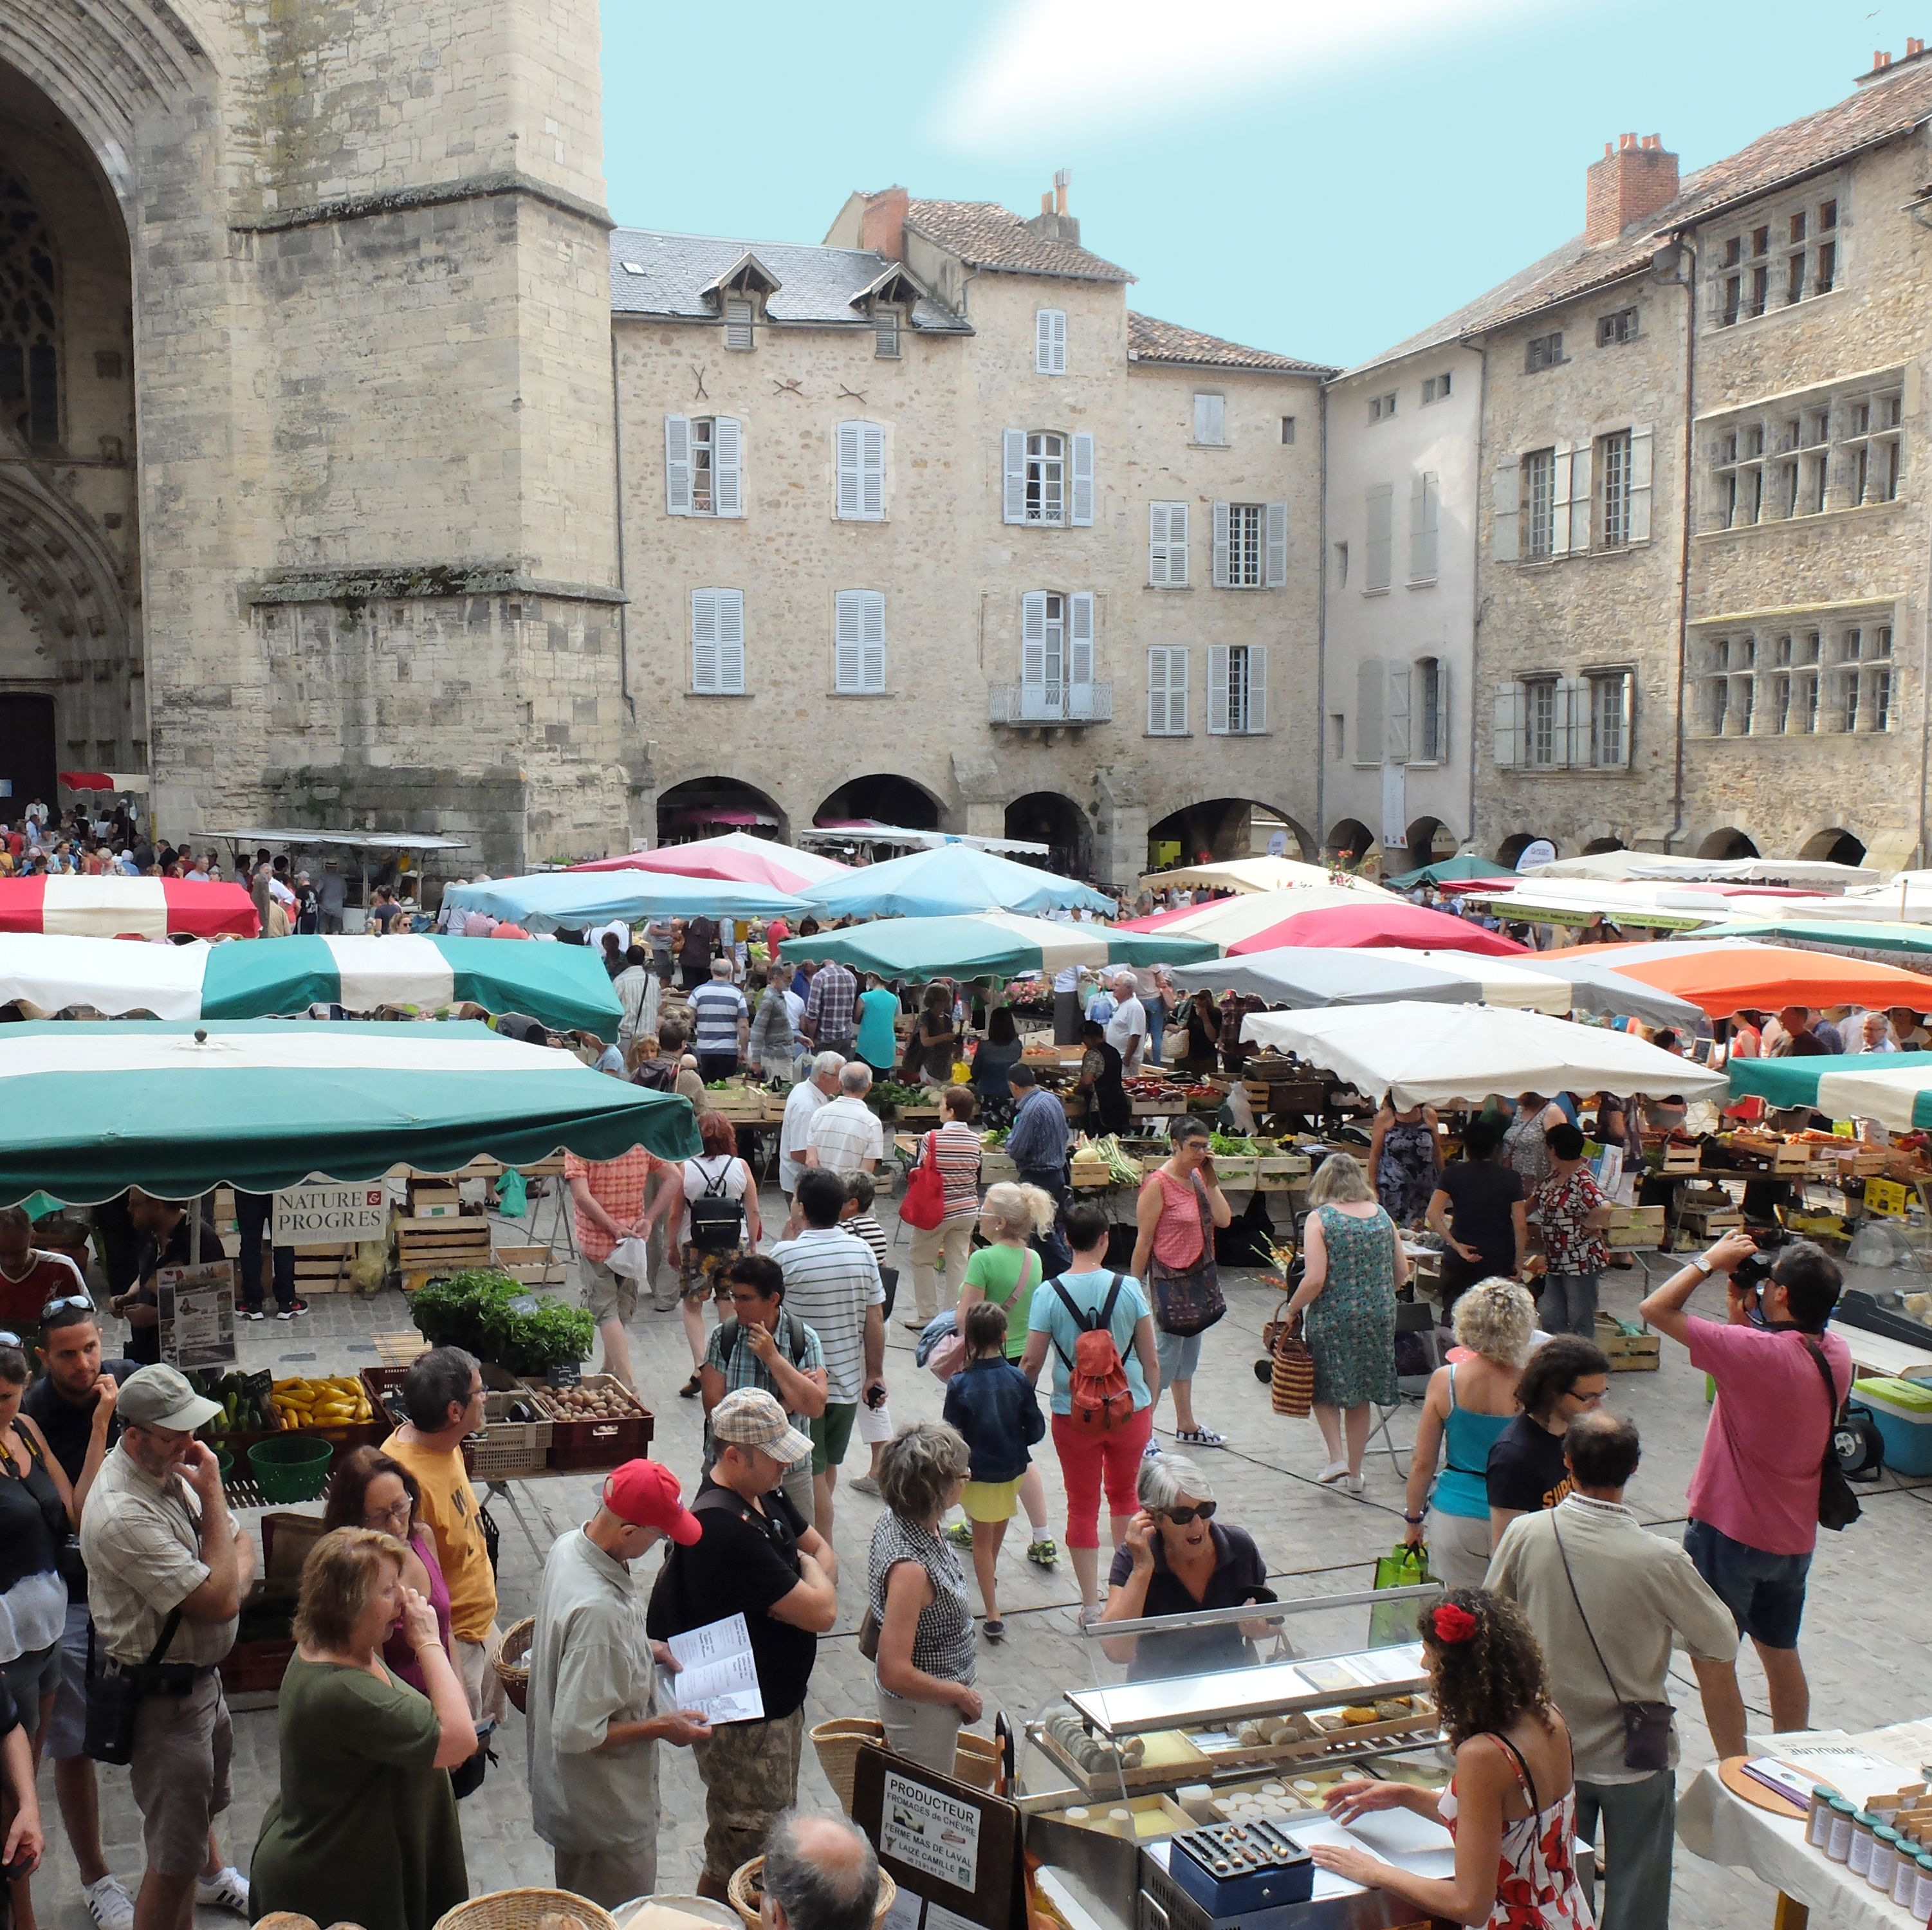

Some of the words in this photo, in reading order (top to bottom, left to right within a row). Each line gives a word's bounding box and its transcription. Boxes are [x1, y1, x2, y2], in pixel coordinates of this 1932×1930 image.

[277, 1191, 363, 1211] NATURE
[367, 1191, 381, 1205] &
[1784, 1746, 1865, 1756] SPIRULINE
[887, 1792, 930, 1817] FROMAGES
[932, 1812, 942, 1822] de
[890, 1778, 975, 1824] PRODUCTEUR
[885, 1823, 911, 1841] FERME
[913, 1835, 931, 1850] MAS
[933, 1843, 944, 1855] DE
[946, 1848, 972, 1868] LAVAL
[921, 1852, 955, 1873] CAMILLE
